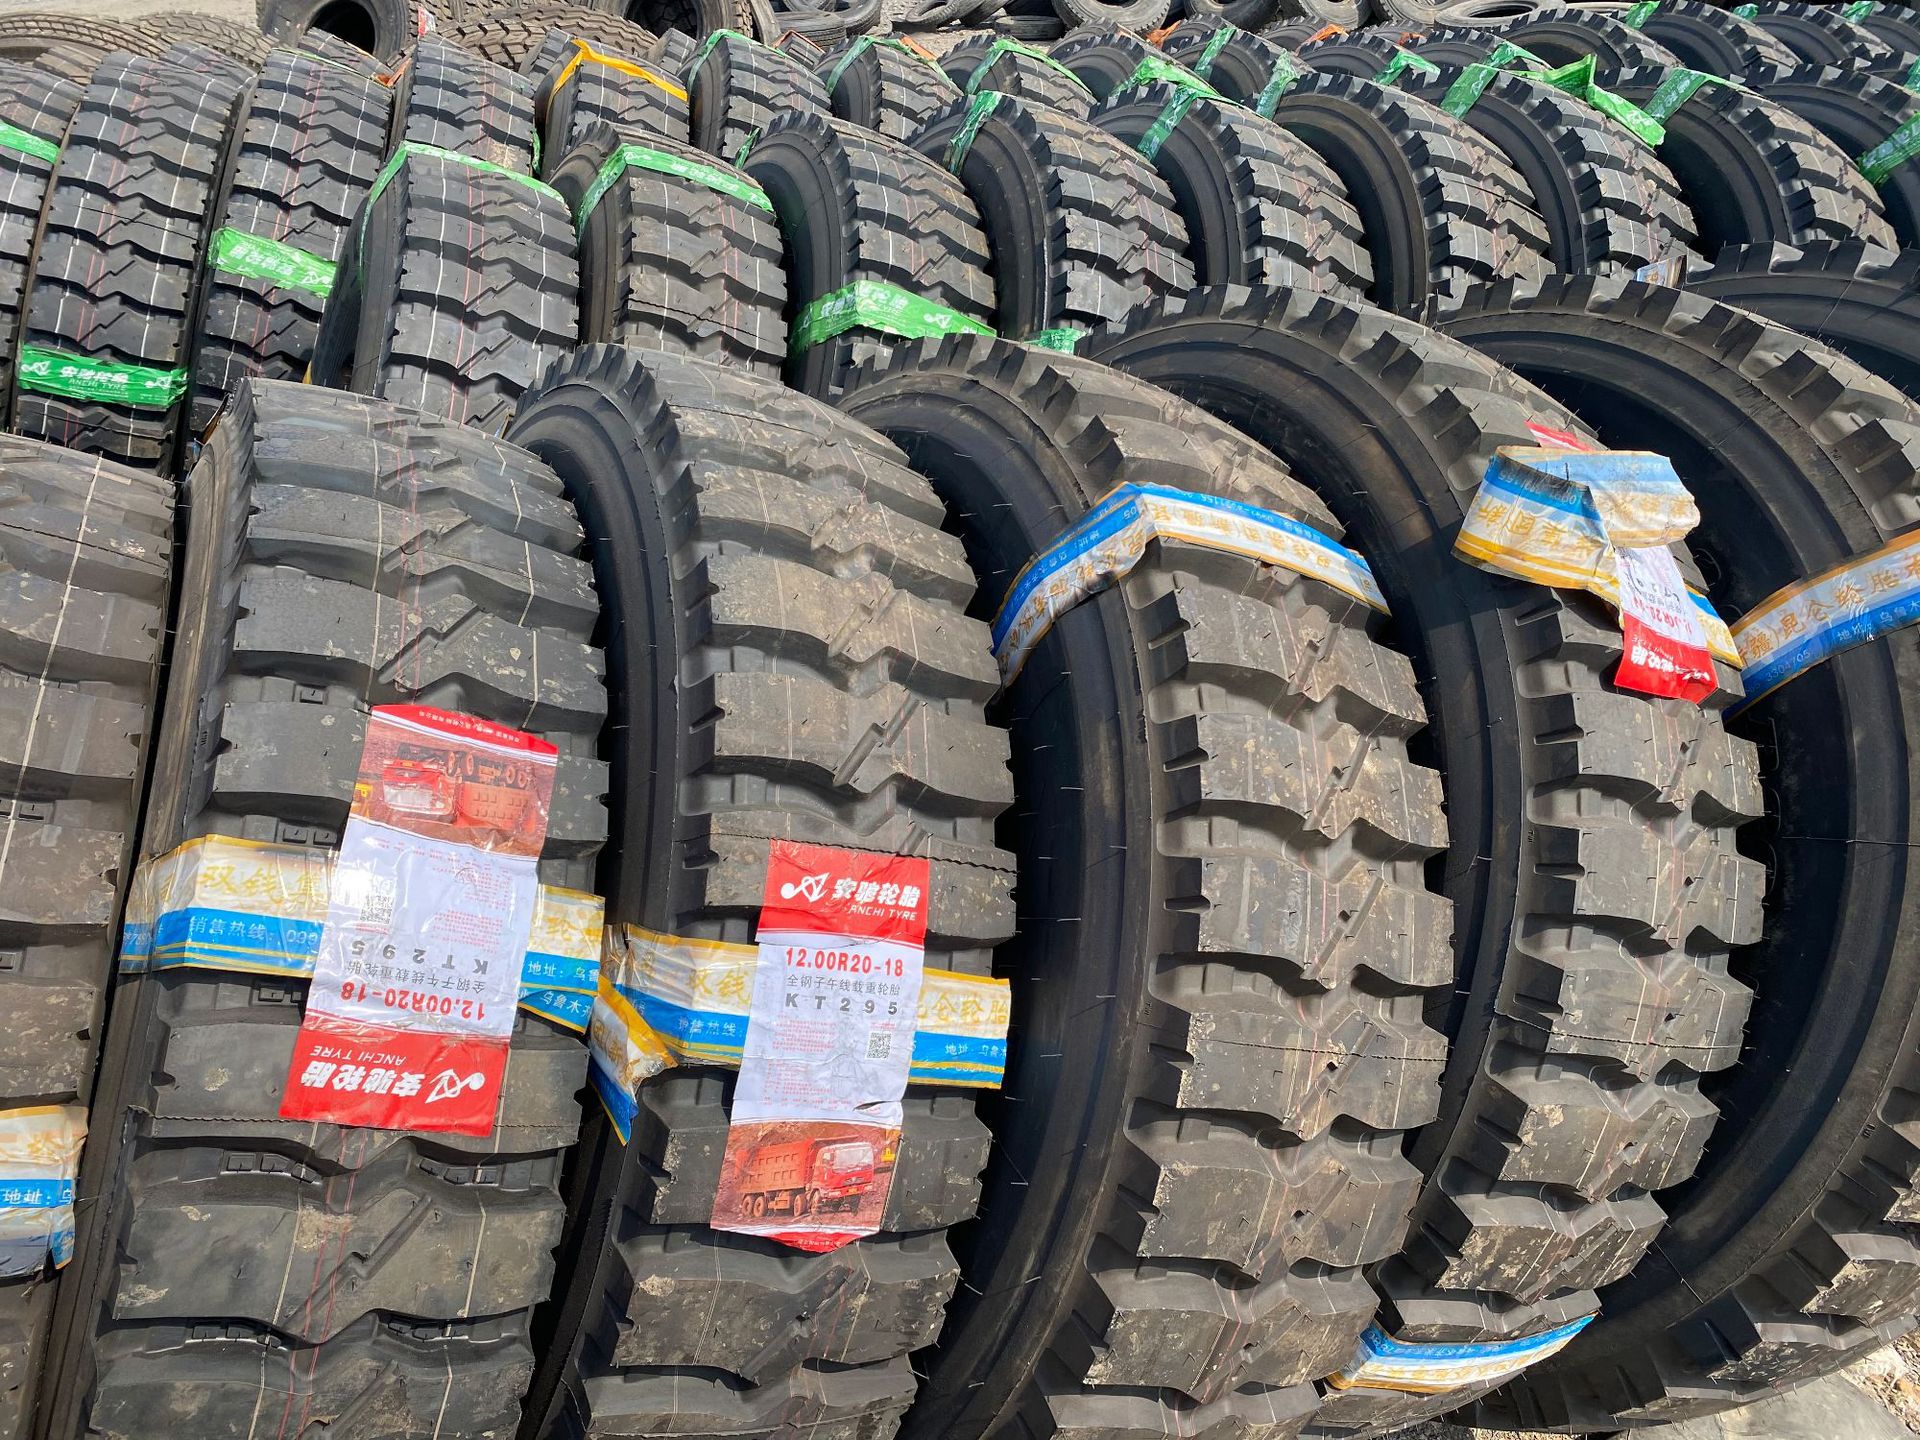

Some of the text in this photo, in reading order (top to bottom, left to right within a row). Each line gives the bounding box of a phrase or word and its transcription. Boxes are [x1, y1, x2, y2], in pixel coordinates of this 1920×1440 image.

[848, 904, 918, 922] ANCHI TYRE
[786, 947, 904, 977] 12.00R20-18
[346, 960, 486, 995] 全钢子午线载重轮胎
[786, 974, 901, 996] 全钢子午线载重轮胎
[340, 981, 485, 1022] 12.00R20-18
[309, 1045, 407, 1066] ANCHI TYRE
[300, 1060, 426, 1098] 安驰轮胎
